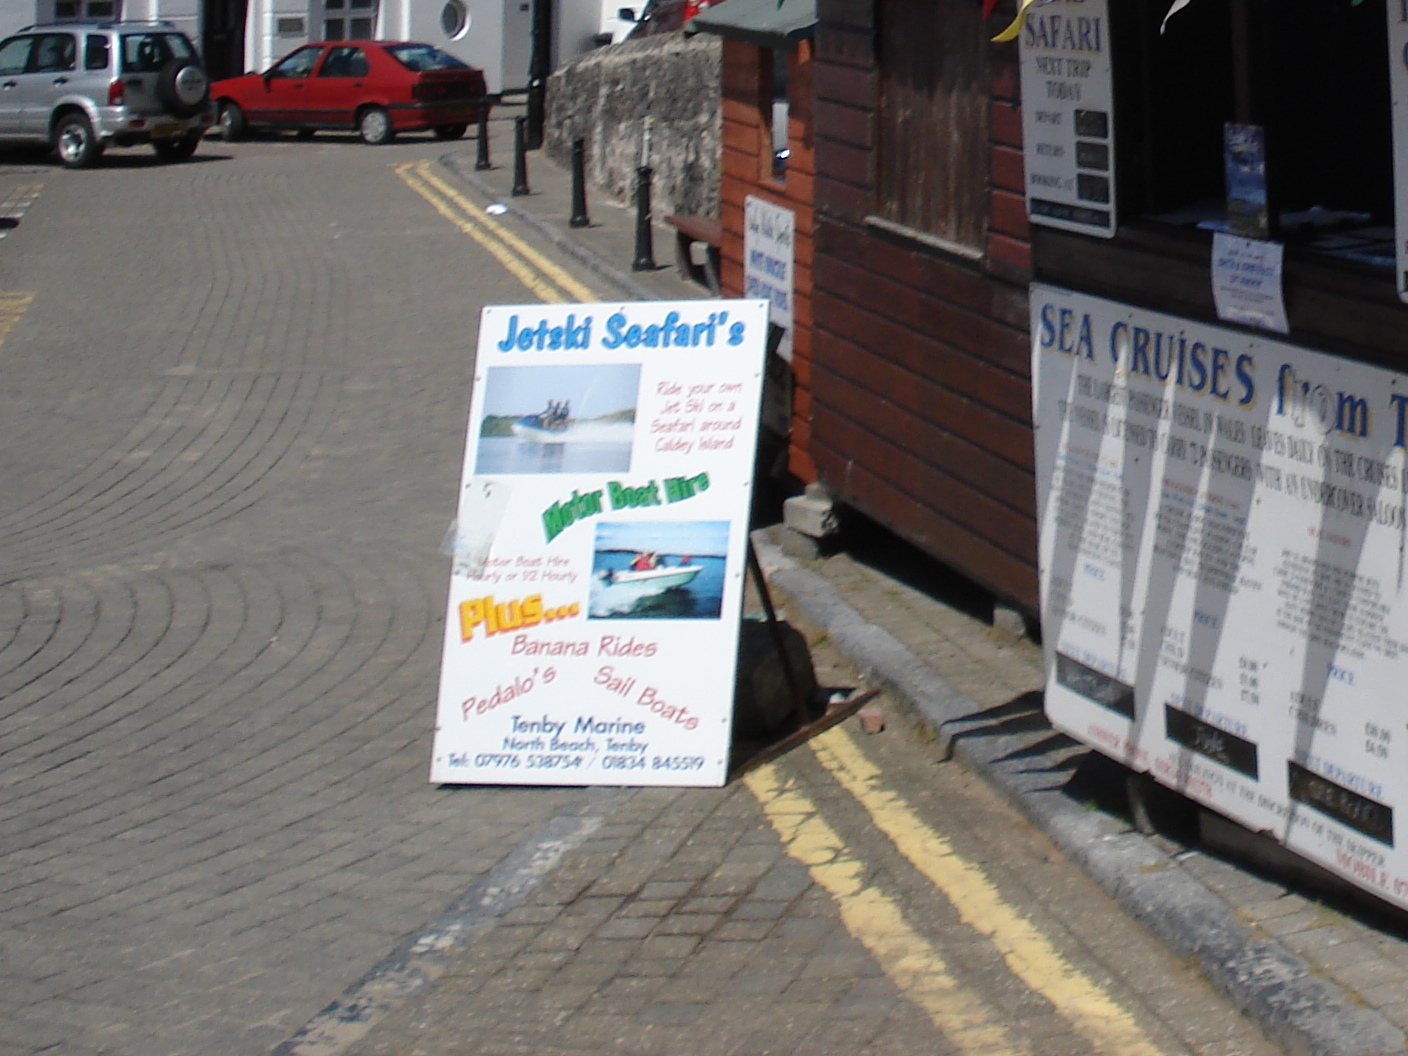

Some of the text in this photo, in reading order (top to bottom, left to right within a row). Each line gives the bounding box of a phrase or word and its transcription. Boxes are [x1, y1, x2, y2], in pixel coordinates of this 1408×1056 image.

[1026, 13, 1101, 52] SAFARI
[497, 311, 745, 352] Jetski Seafari's
[1039, 302, 1095, 361] SEA
[1110, 320, 1256, 410] CRUISES
[657, 382, 743, 398] Ride your own
[686, 399, 704, 413] Ski
[708, 402, 723, 412] on
[728, 402, 736, 412] a
[650, 416, 742, 433] Seafari around
[656, 436, 735, 454] Caldey Island
[542, 472, 710, 541] Motor Boat Hire
[511, 634, 658, 657] Banana Rides
[461, 665, 699, 730] Pedalo's Sail Boats
[511, 715, 646, 736] Tenby Marine
[502, 737, 543, 751] North
[606, 738, 648, 754] Tenby
